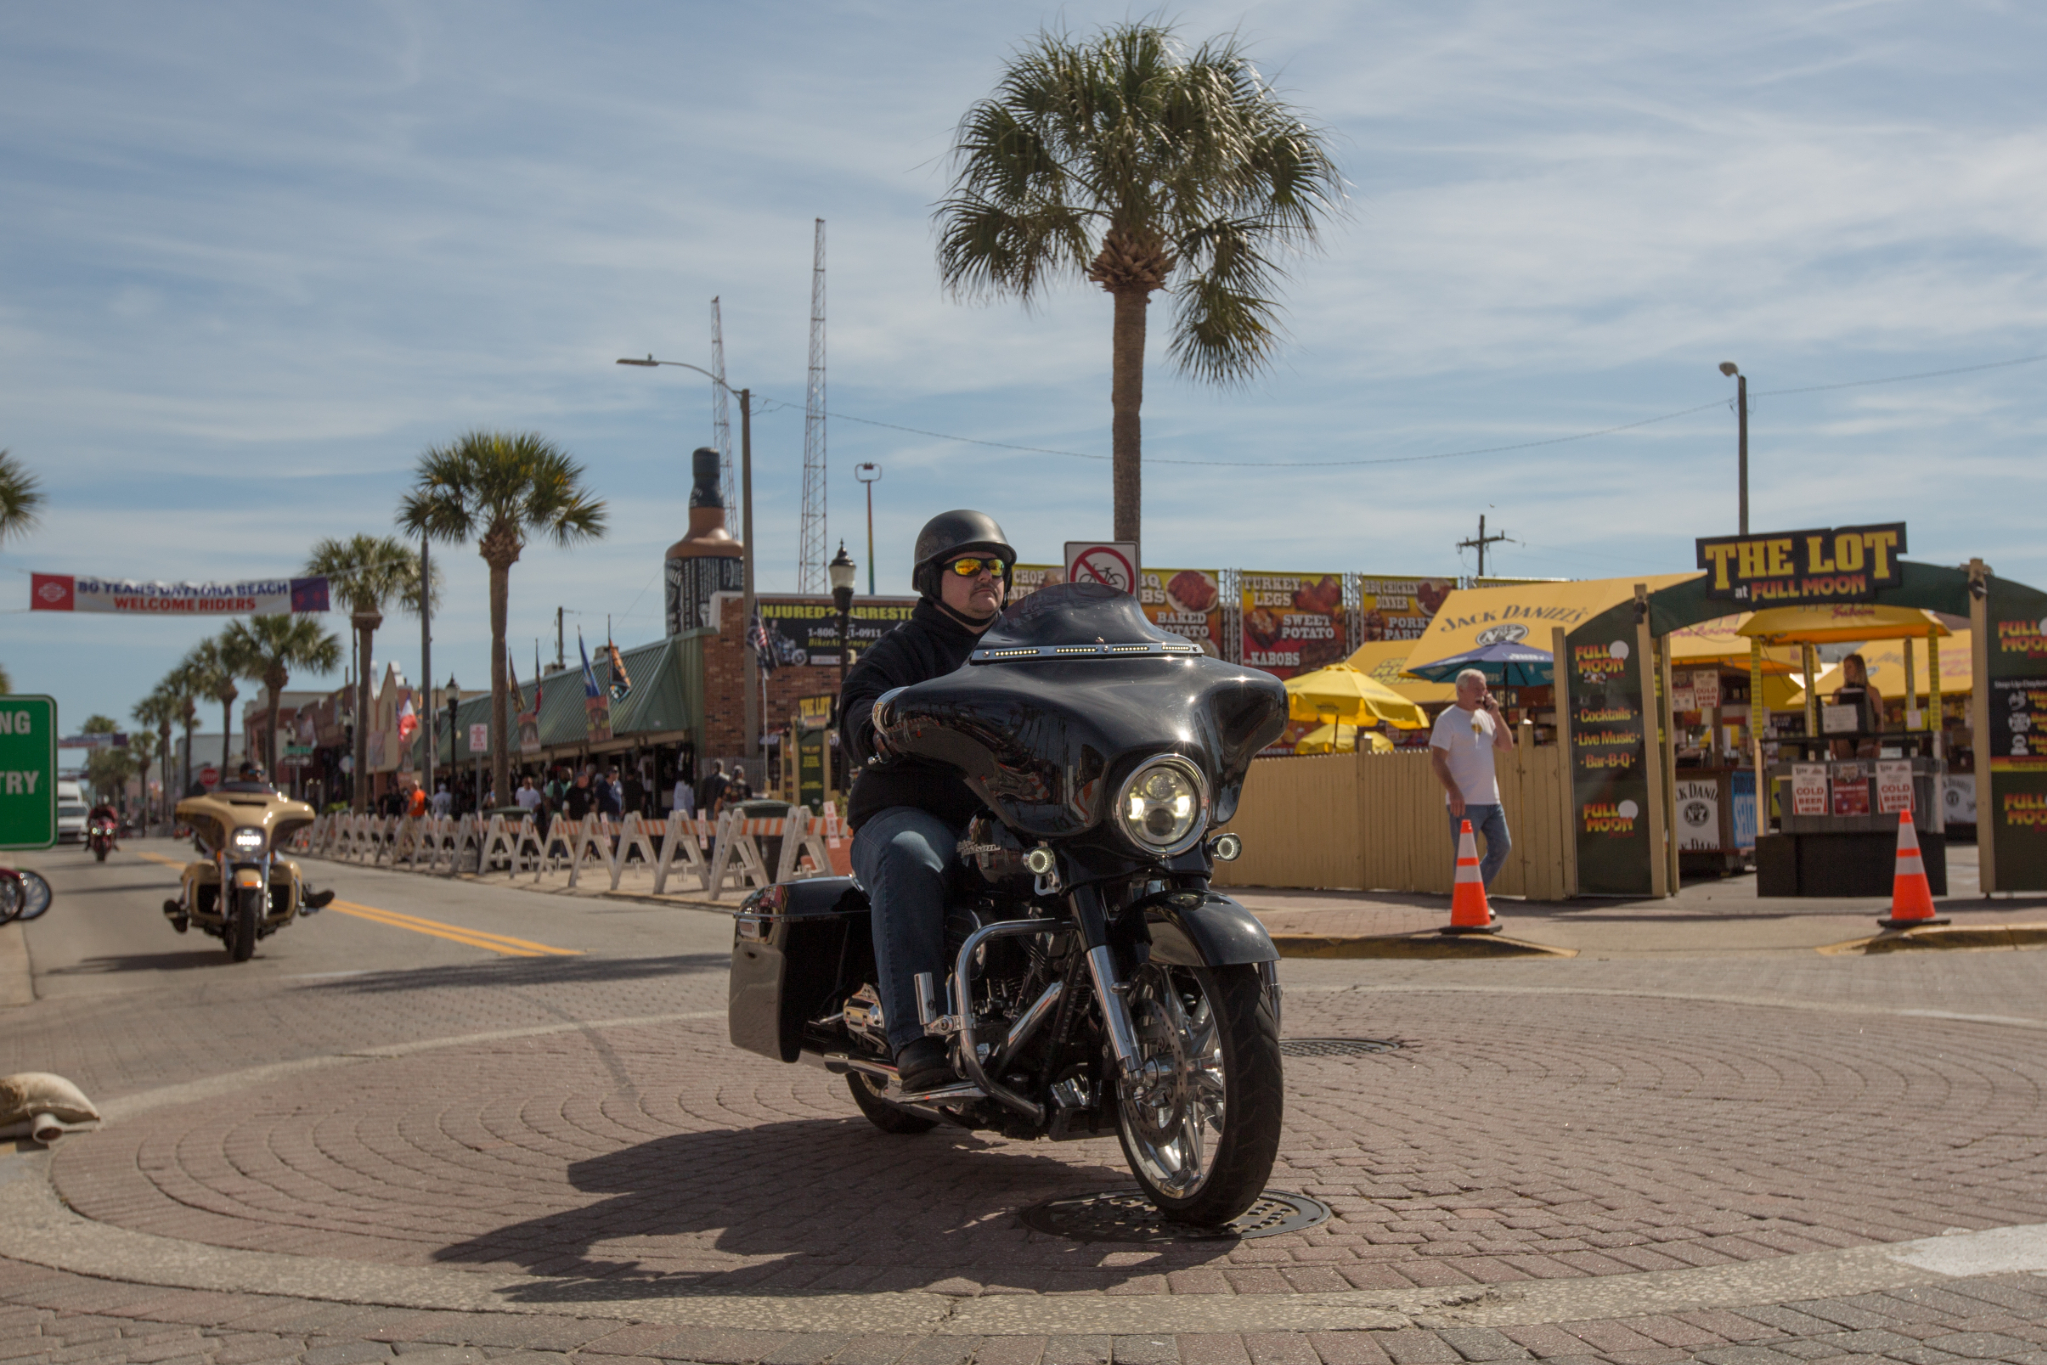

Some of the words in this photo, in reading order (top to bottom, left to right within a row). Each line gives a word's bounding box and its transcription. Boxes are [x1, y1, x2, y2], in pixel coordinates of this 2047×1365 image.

[1704, 538, 1794, 590] THE
[1805, 530, 1898, 580] LOT
[1013, 569, 1046, 585] CHOP
[1243, 576, 1301, 591] TURKEY
[236, 582, 288, 595] BEACH
[1363, 580, 1382, 595] BBQ
[1382, 580, 1419, 595] CHICKEN
[1735, 584, 1748, 599] at
[1751, 579, 1800, 602] FULL
[1802, 574, 1866, 596] MOON
[114, 596, 195, 611] WELCOME
[199, 596, 256, 611] RIDERS
[1253, 592, 1292, 607] LEGS
[1376, 595, 1408, 610] DINNER
[760, 604, 838, 619] NJURED?
[1156, 611, 1207, 624] BAKED
[1282, 614, 1331, 627] SWEET
[1440, 609, 1498, 633] JACK
[1281, 627, 1335, 639] POTATO
[1384, 629, 1425, 641] PARF
[1998, 619, 2040, 639] FULL
[2001, 636, 2047, 653] MOO
[1250, 652, 1300, 666] KABOBS
[1574, 643, 1610, 662] FULL
[1578, 656, 1625, 674] MOON
[1580, 707, 1631, 723] Cocktails
[1578, 731, 1600, 746] Live
[1601, 729, 1636, 745] Music
[1585, 752, 1631, 769] Bar-B-Q
[0, 771, 40, 795] RY
[1880, 784, 1911, 793] COLD
[1795, 786, 1824, 796] COLD
[1883, 794, 1910, 802] BEER
[1798, 797, 1823, 805] BEER
[2004, 793, 2046, 811] FULL
[1583, 802, 1620, 820] FULL
[1586, 816, 1634, 832] MOON
